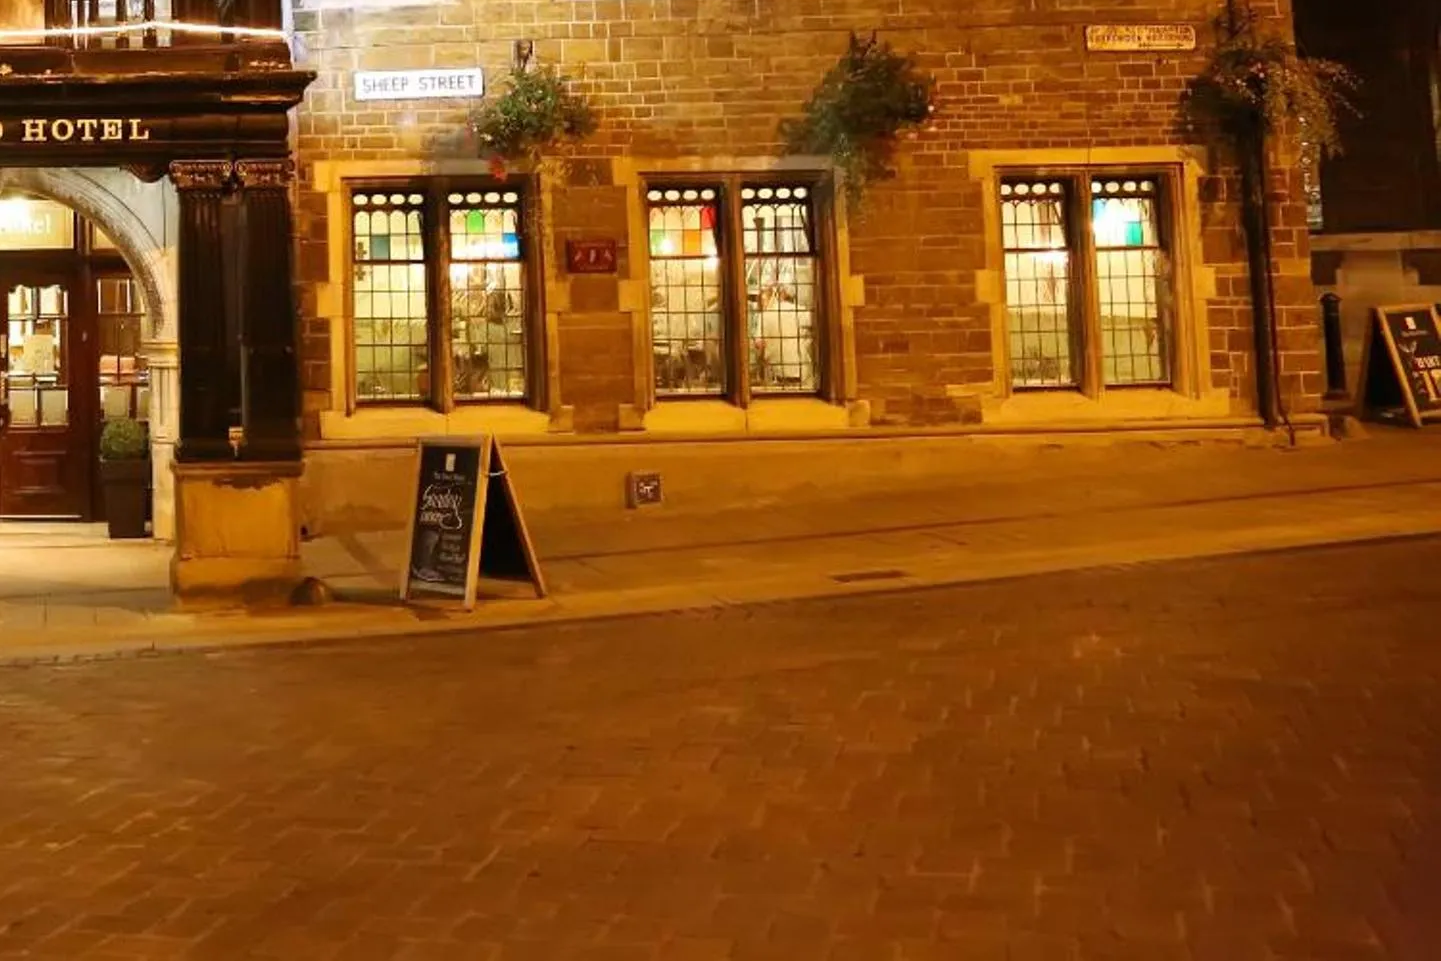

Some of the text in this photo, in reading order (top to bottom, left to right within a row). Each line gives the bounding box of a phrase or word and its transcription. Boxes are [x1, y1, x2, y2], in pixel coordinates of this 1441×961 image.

[362, 74, 476, 94] SHEEP STREET
[22, 118, 151, 141] HOTEL
